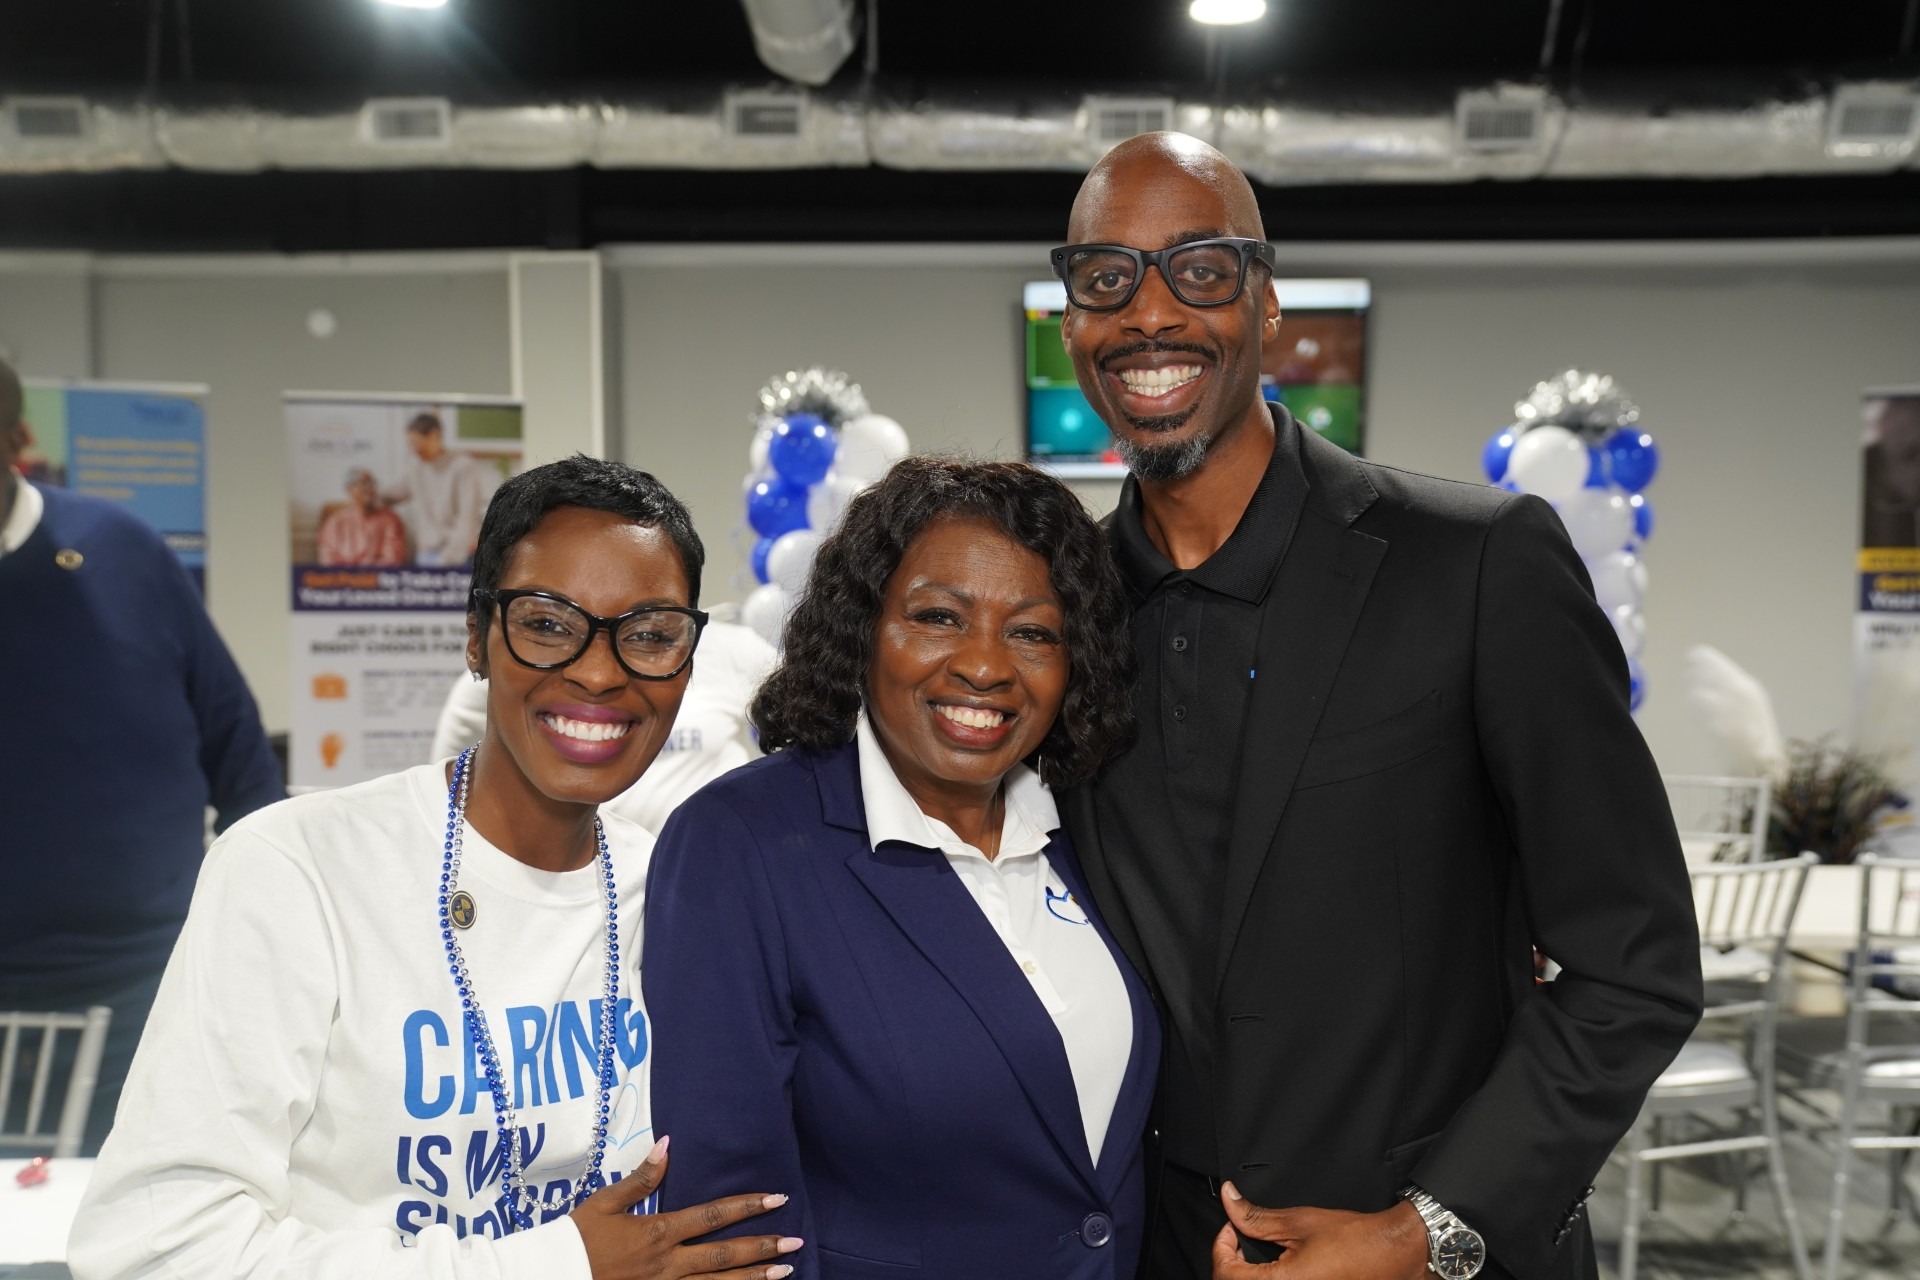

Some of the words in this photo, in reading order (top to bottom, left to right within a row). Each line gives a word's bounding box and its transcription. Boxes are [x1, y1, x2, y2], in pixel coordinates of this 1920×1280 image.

[402, 997, 648, 1120] CARING
[397, 1134, 452, 1198] IS
[465, 1122, 546, 1200] MY
